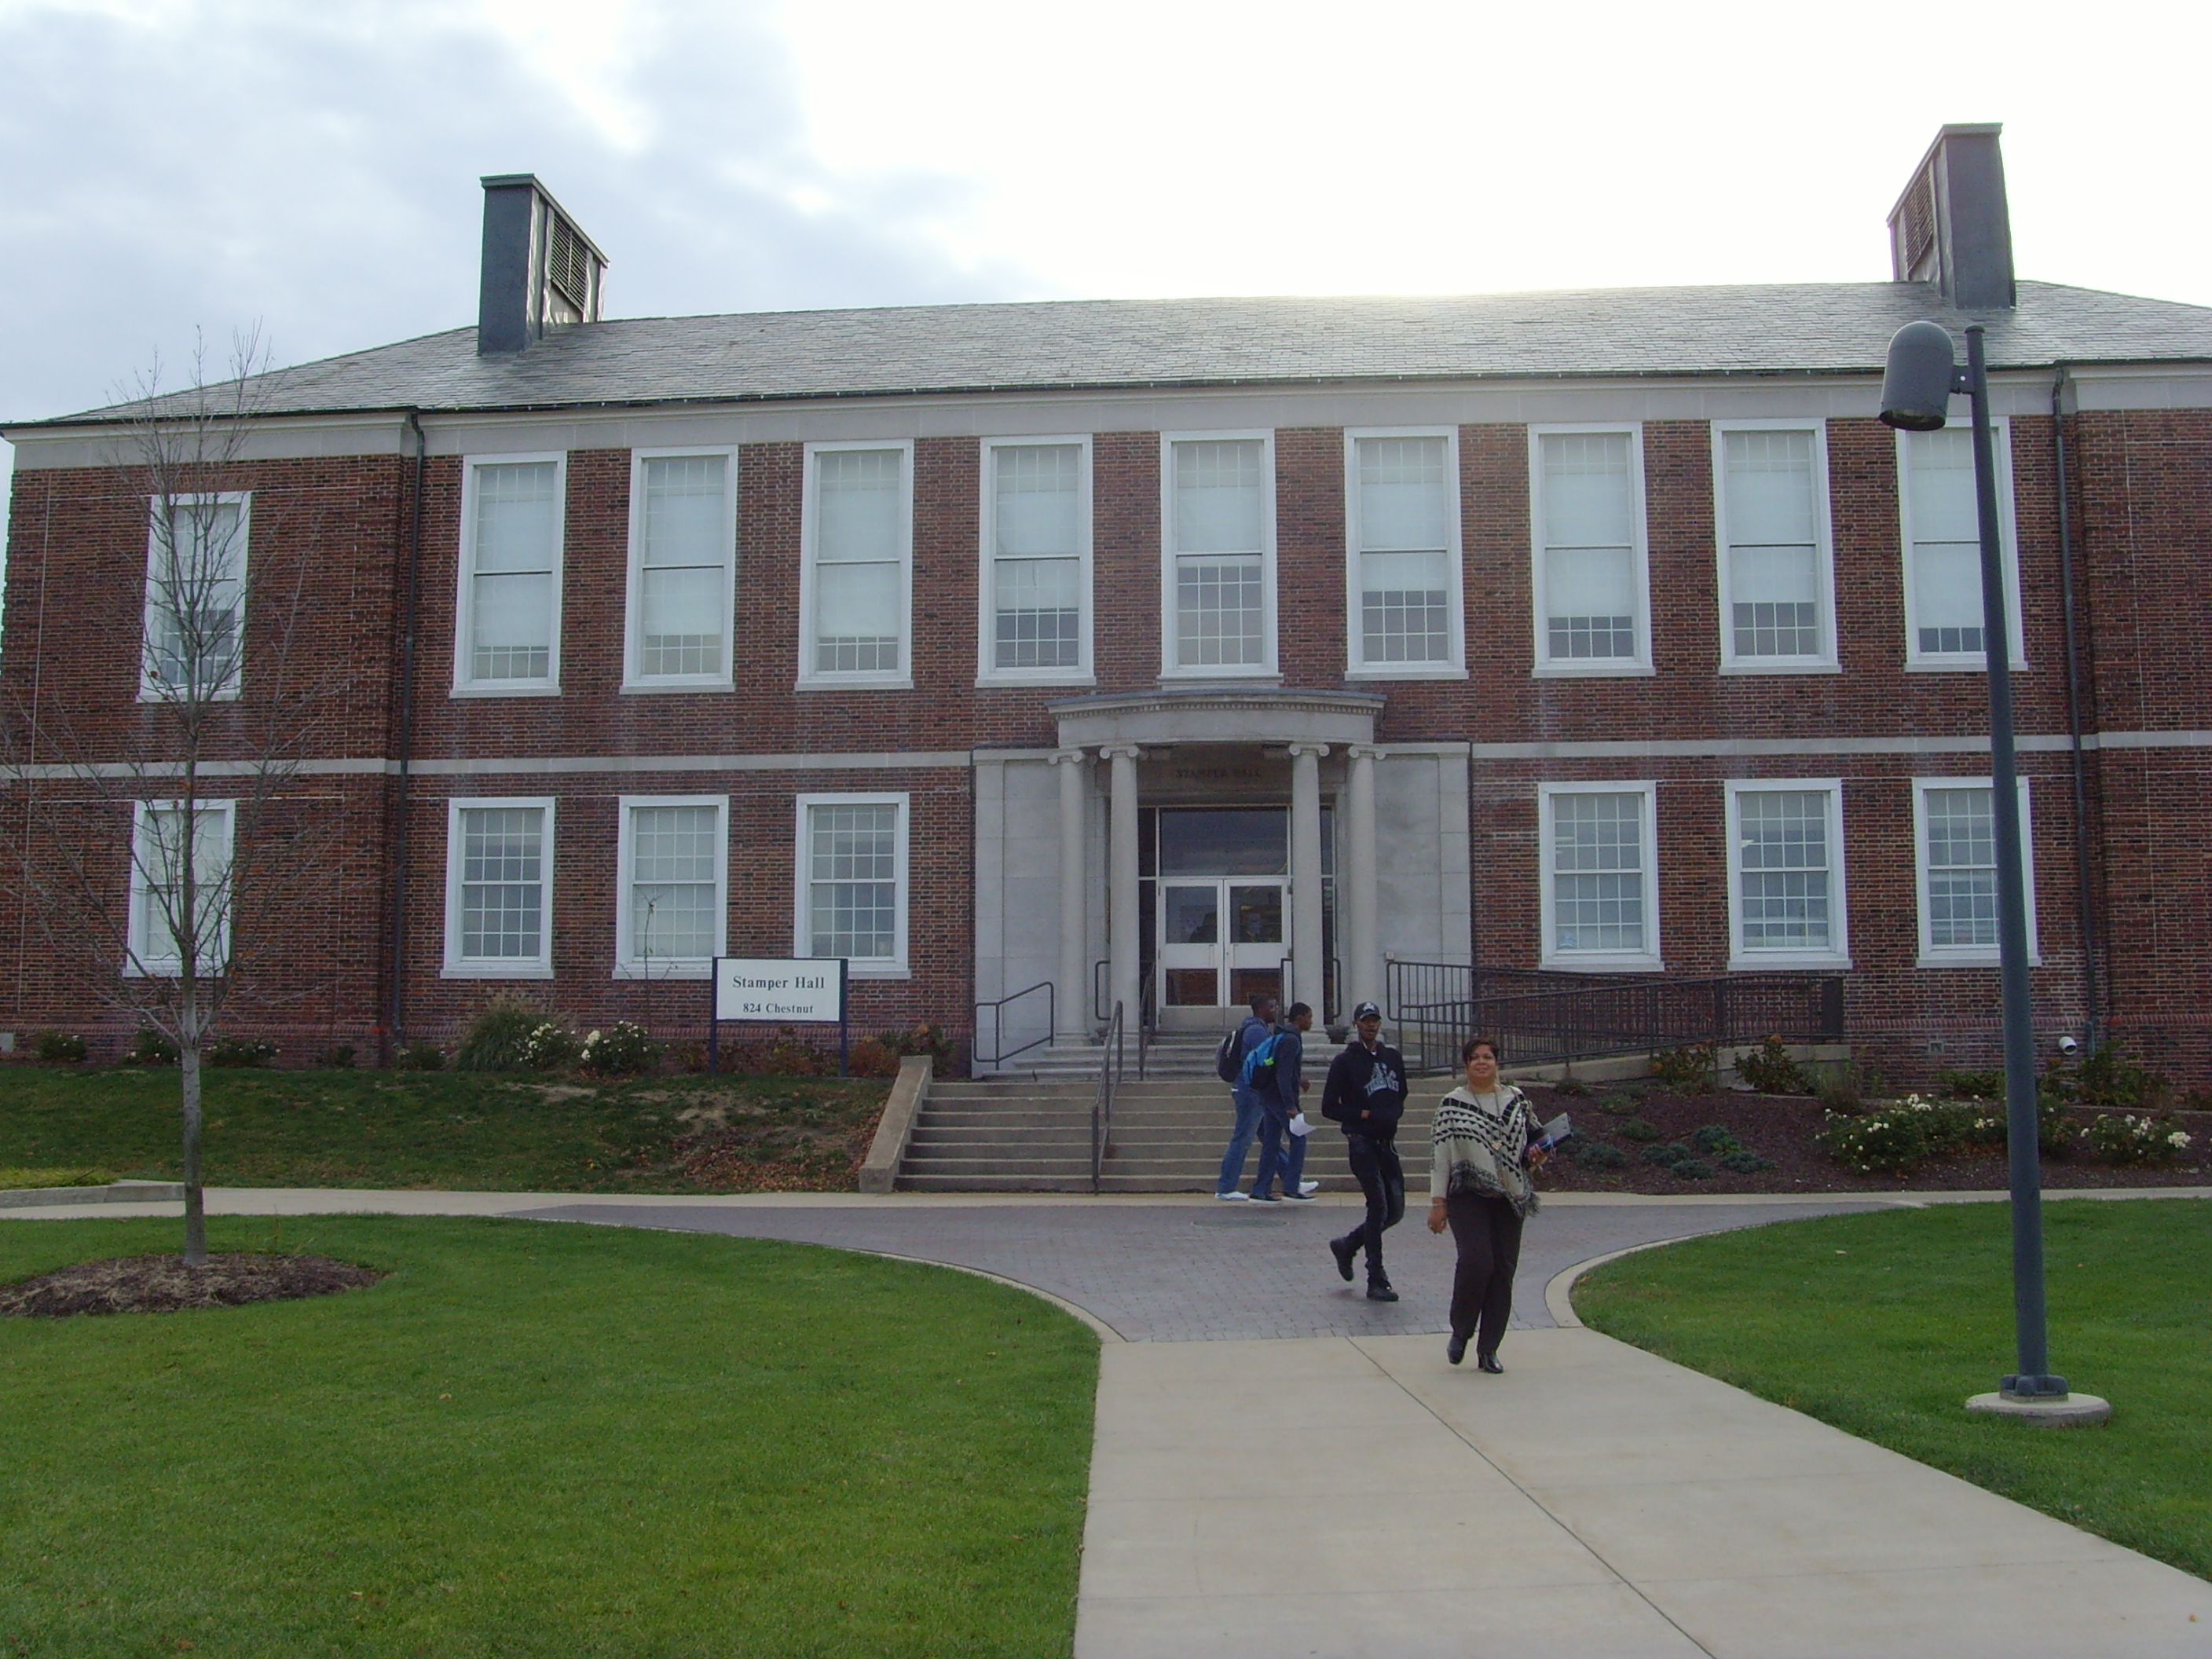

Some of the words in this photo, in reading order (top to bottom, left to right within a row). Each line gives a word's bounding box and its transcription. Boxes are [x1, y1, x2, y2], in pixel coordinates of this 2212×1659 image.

[732, 976, 789, 991] Stamper
[794, 976, 825, 989] Hall
[743, 1002, 762, 1013] 824
[766, 1002, 814, 1013] Chestnut
